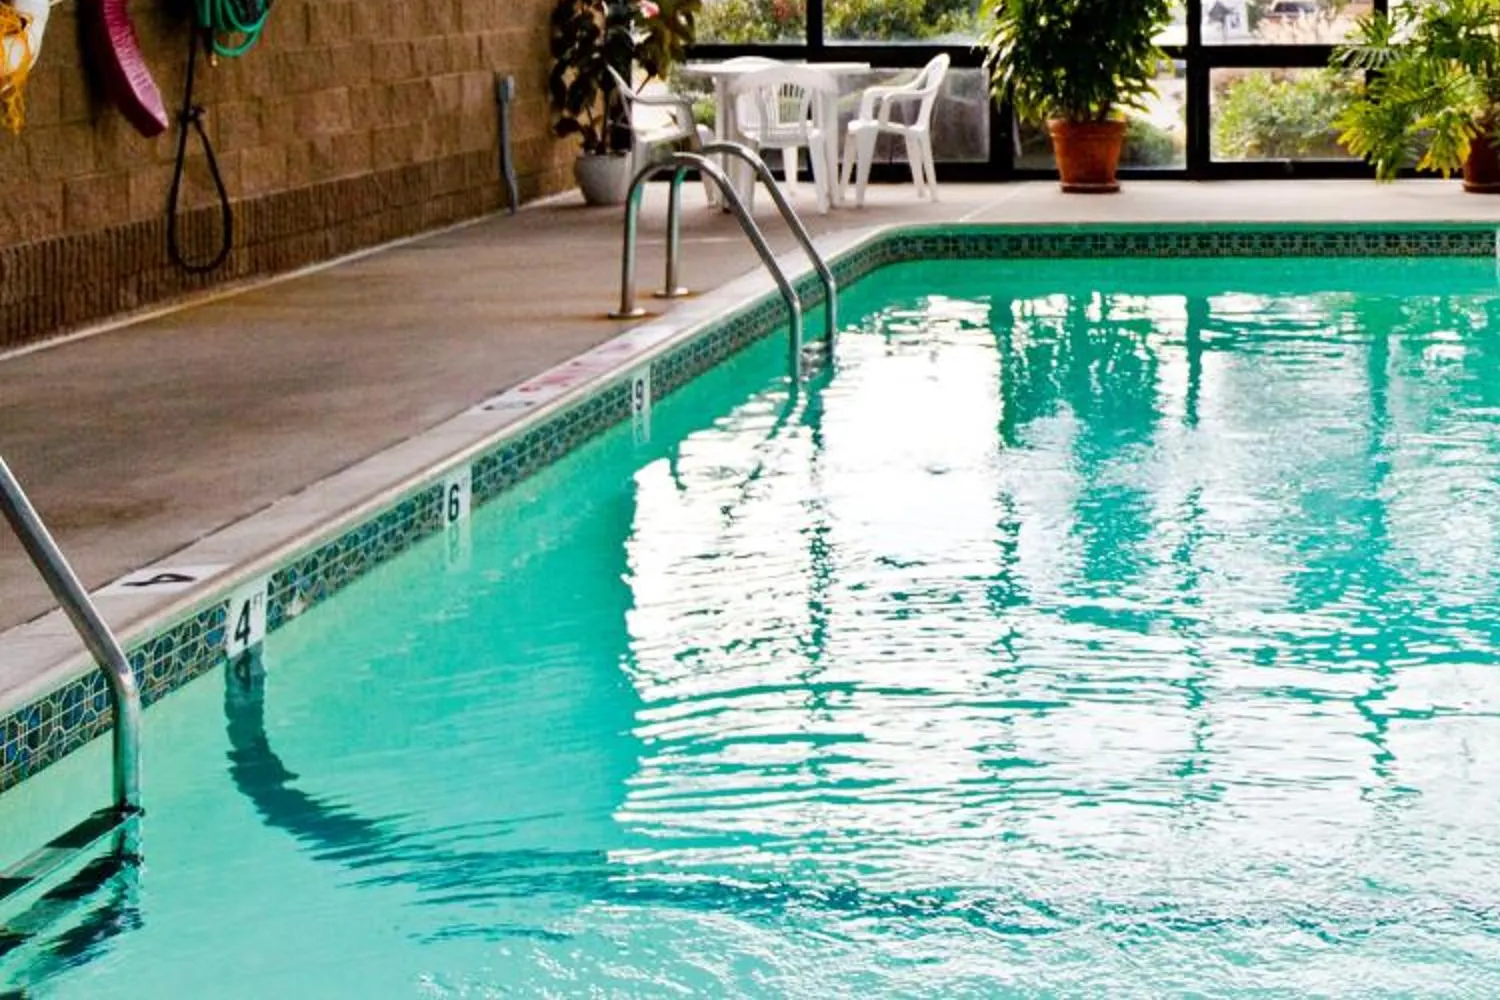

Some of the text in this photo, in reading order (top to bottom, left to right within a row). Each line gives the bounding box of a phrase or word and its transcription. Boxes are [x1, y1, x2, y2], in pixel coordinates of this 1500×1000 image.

[635, 379, 644, 411] 9
[448, 483, 460, 522] 6
[234, 599, 251, 646] 4
